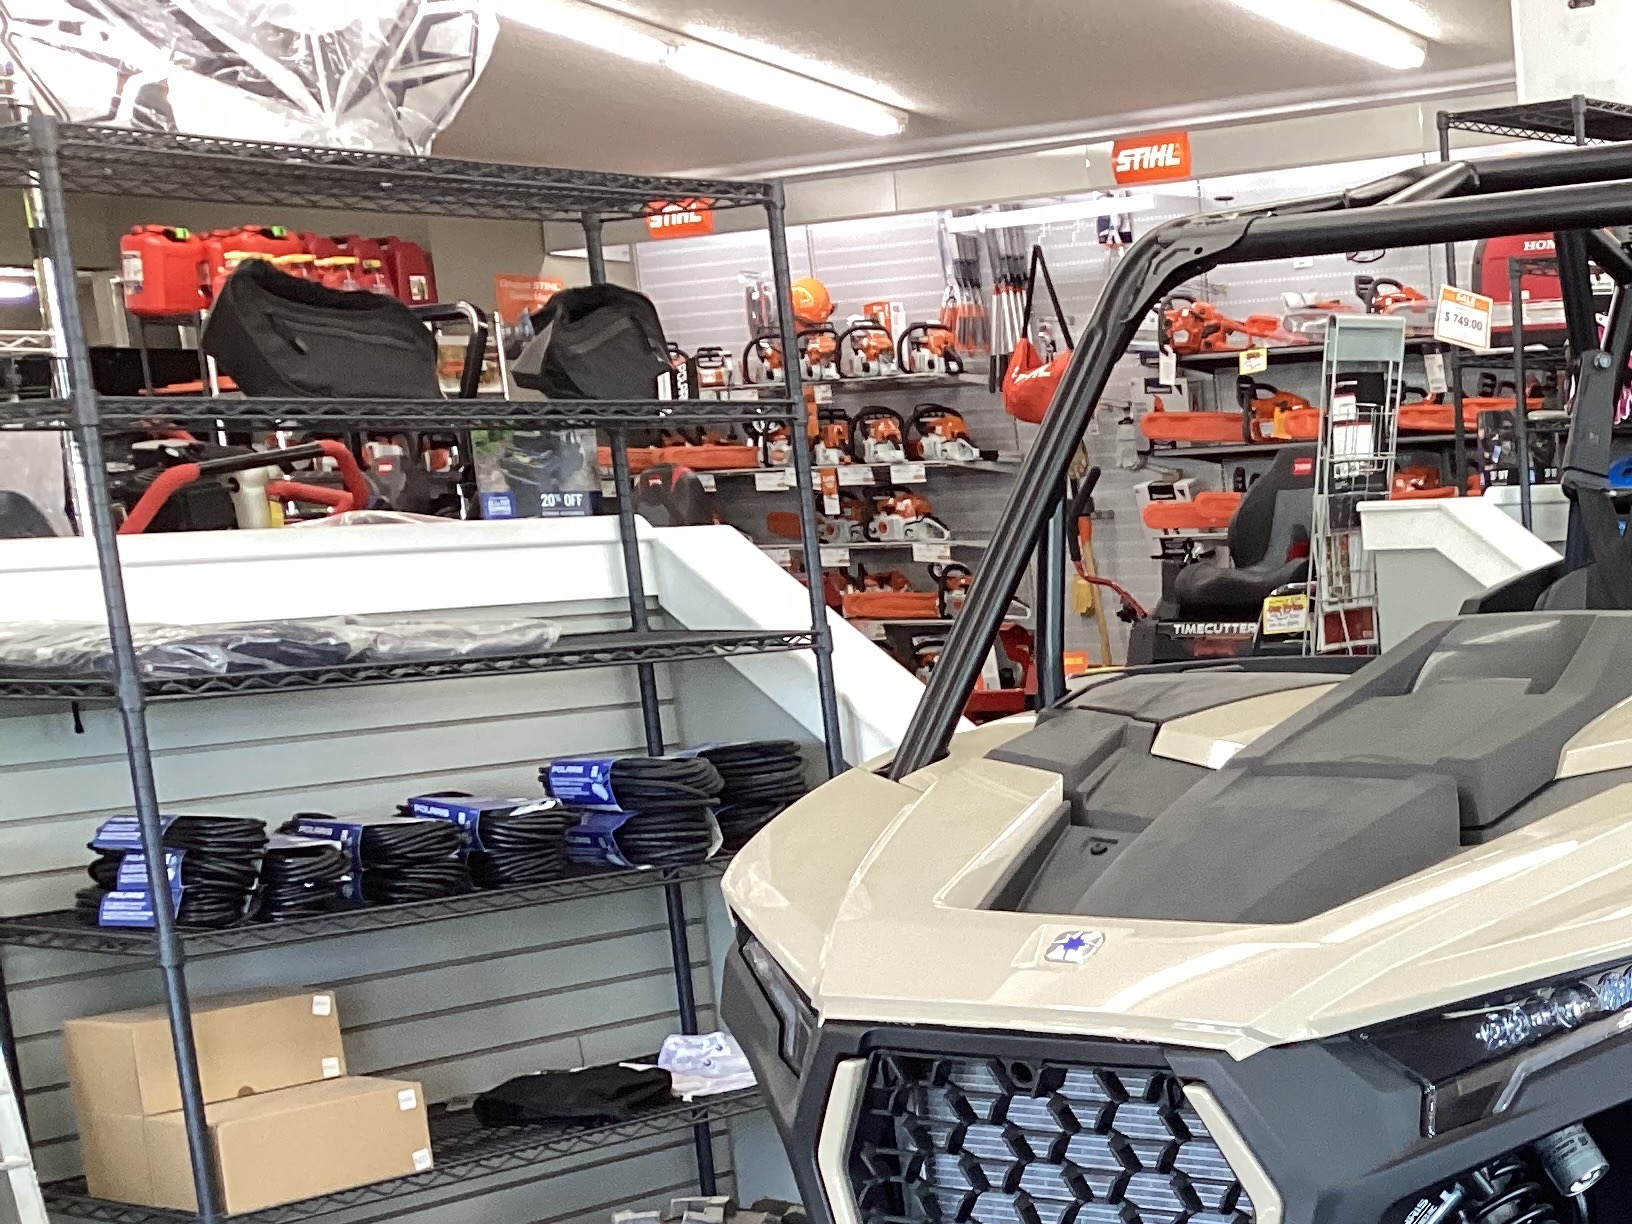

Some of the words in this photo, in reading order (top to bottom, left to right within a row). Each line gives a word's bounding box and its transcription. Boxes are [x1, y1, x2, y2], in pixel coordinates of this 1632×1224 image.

[1116, 143, 1180, 172] STIHL
[1523, 240, 1555, 251] HON
[1453, 313, 1483, 331] 749.00
[677, 363, 689, 400] POLAR
[563, 493, 583, 507] OFF
[1173, 623, 1258, 635] TIMECUTTER
